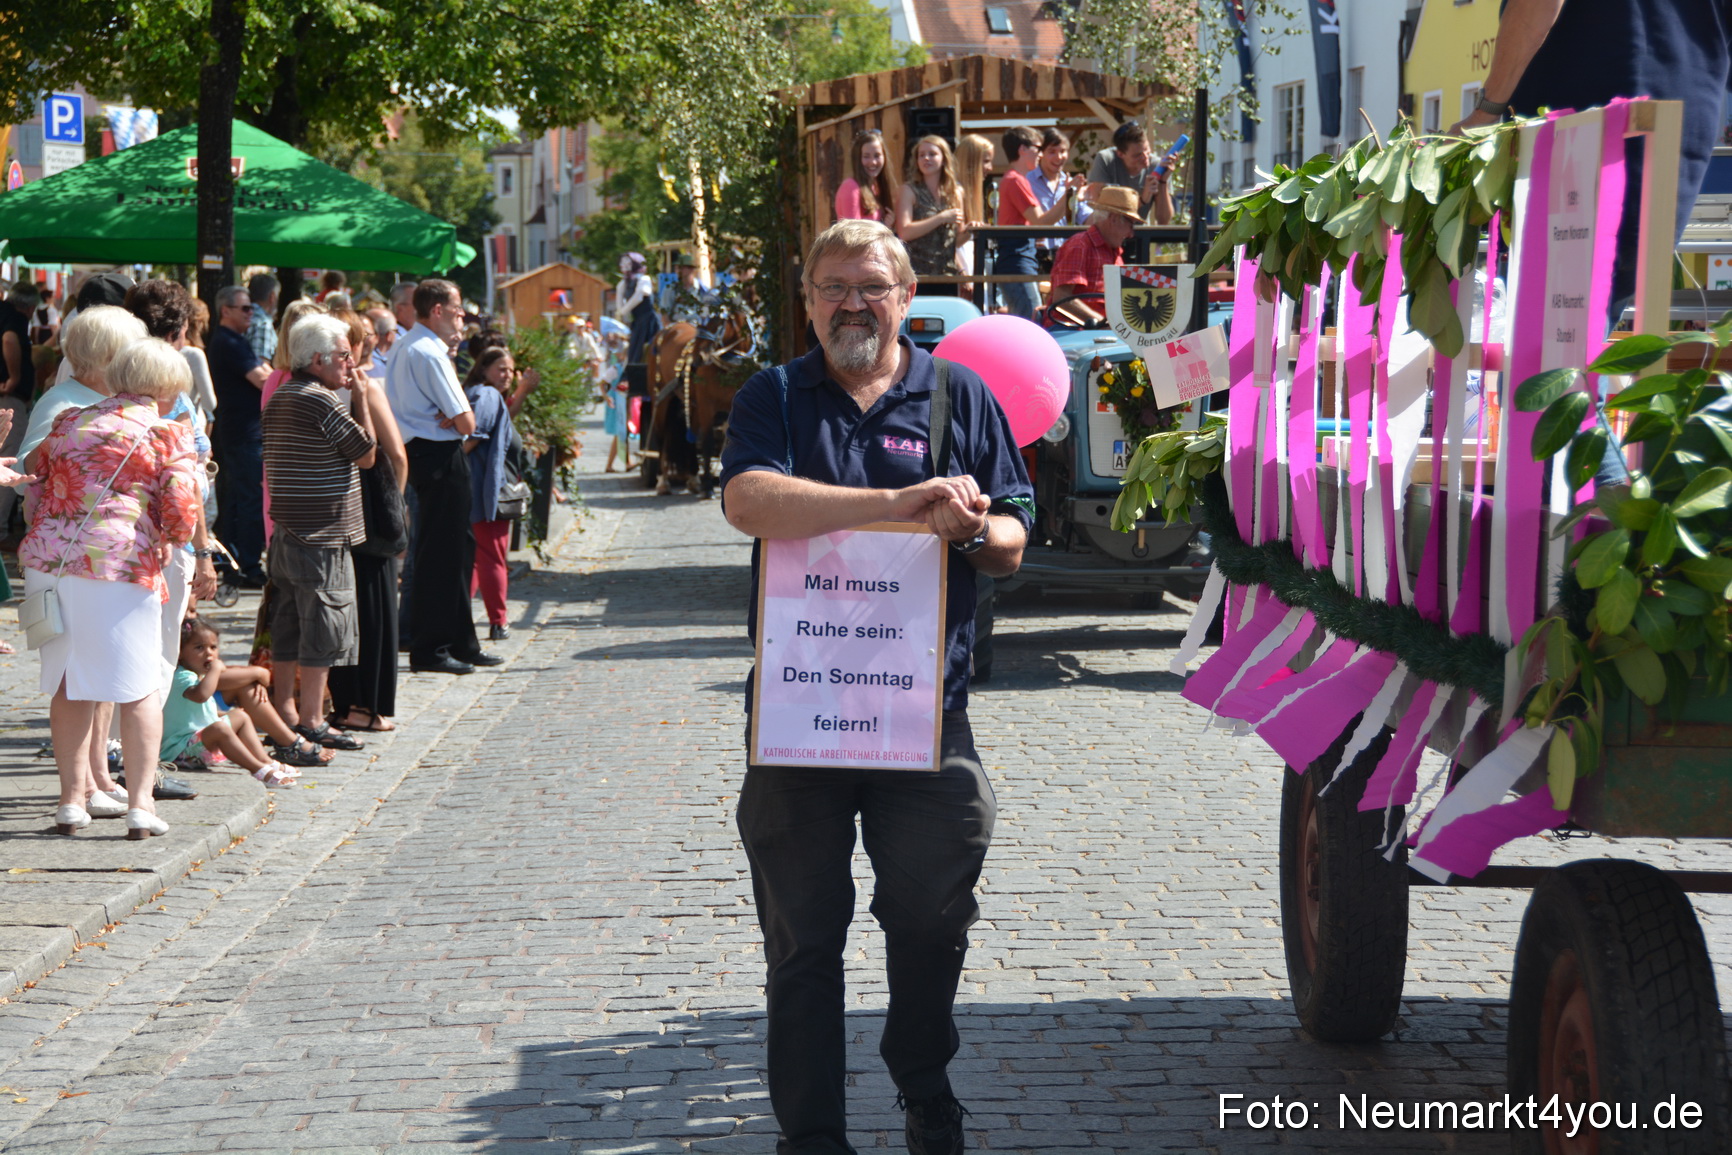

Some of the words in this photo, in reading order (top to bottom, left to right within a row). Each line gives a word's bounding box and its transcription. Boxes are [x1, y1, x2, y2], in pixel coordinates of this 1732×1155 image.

[52, 98, 74, 136] P
[1114, 322, 1131, 340] CAJ
[1180, 384, 1214, 401] BEWEGUNG
[883, 434, 929, 454] KAB
[804, 574, 839, 591] Mal
[845, 579, 900, 593] muss
[796, 620, 849, 637] Ruhe
[855, 623, 904, 640] sein:
[783, 666, 822, 683] Den
[829, 668, 913, 690] Sonntag
[813, 715, 878, 732] feiern!
[763, 747, 817, 759] KATHOLISCHE
[819, 749, 928, 762] ARBEITNEHMER-BEWEGUNG
